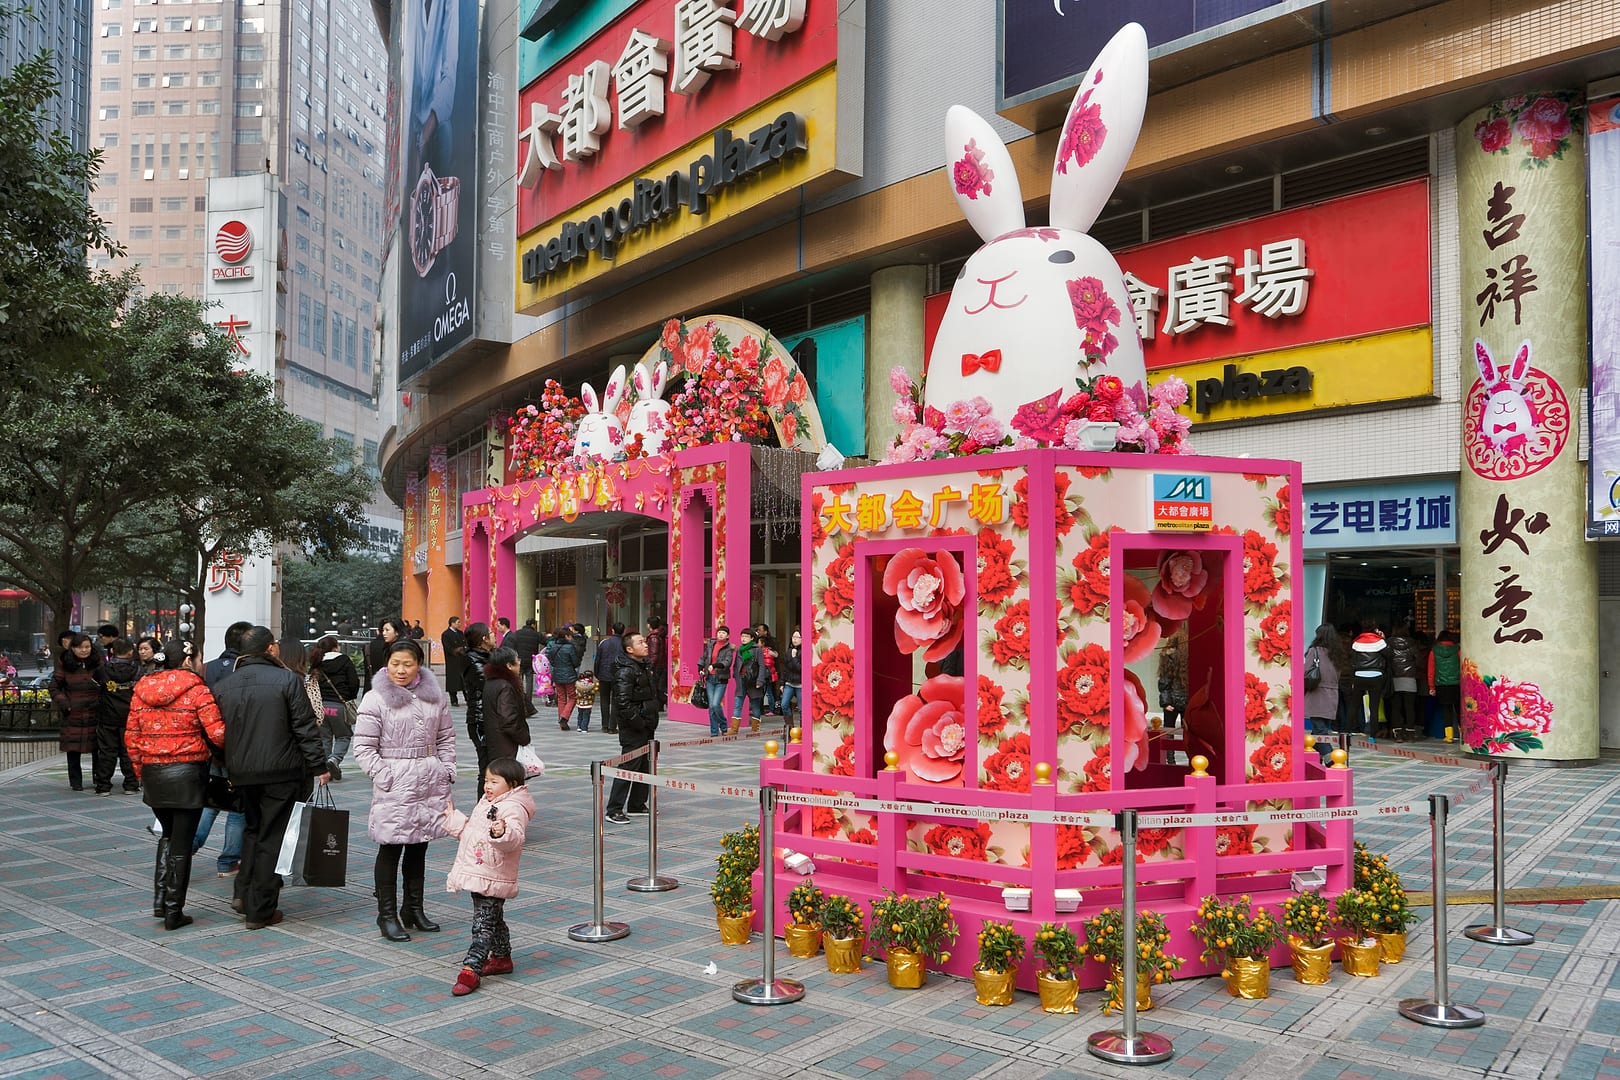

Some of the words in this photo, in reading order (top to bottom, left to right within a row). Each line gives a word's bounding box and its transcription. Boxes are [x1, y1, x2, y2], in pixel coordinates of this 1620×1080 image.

[522, 170, 686, 283] metropolitan
[689, 111, 807, 214] plaza
[212, 266, 251, 281] PACIFIC
[434, 296, 470, 342] OMEGA
[1196, 364, 1314, 414] plaza
[823, 483, 1007, 534] 大都会广场
[1158, 505, 1209, 517] 大都會廣場
[720, 786, 754, 798] 大都会广场
[777, 793, 832, 806] metropolitan
[833, 798, 860, 808] plaza
[880, 803, 913, 812] 大都会广场
[934, 806, 997, 819] metropolitan
[998, 810, 1029, 821] plaza
[1378, 804, 1411, 814] 大都会广场
[1052, 815, 1091, 824] 大都会广场
[1163, 815, 1193, 825] plaza
[1214, 814, 1249, 823] 大都会广场
[1270, 809, 1330, 821] metropolitan
[1331, 808, 1358, 819] plaza
